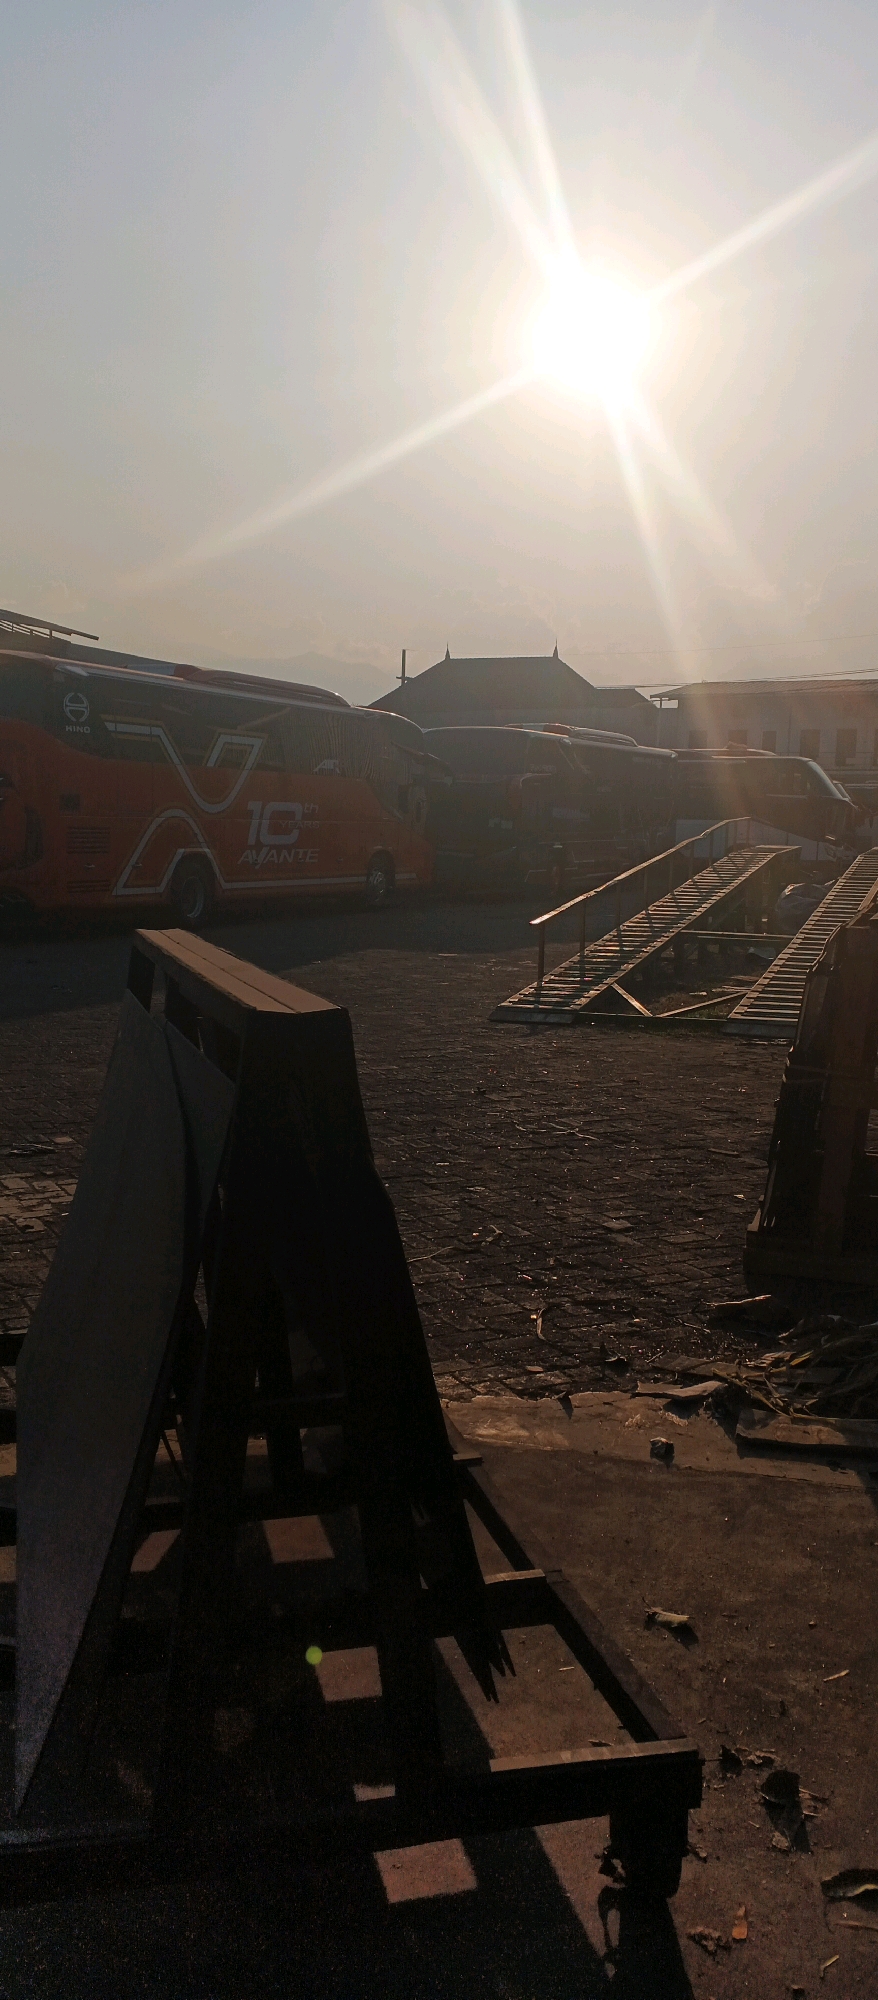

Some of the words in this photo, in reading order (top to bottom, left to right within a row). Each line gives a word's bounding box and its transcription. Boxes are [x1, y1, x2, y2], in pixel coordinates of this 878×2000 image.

[65, 725, 91, 734] HINO
[279, 820, 320, 829] YEARS
[237, 846, 320, 869] AVANTE
